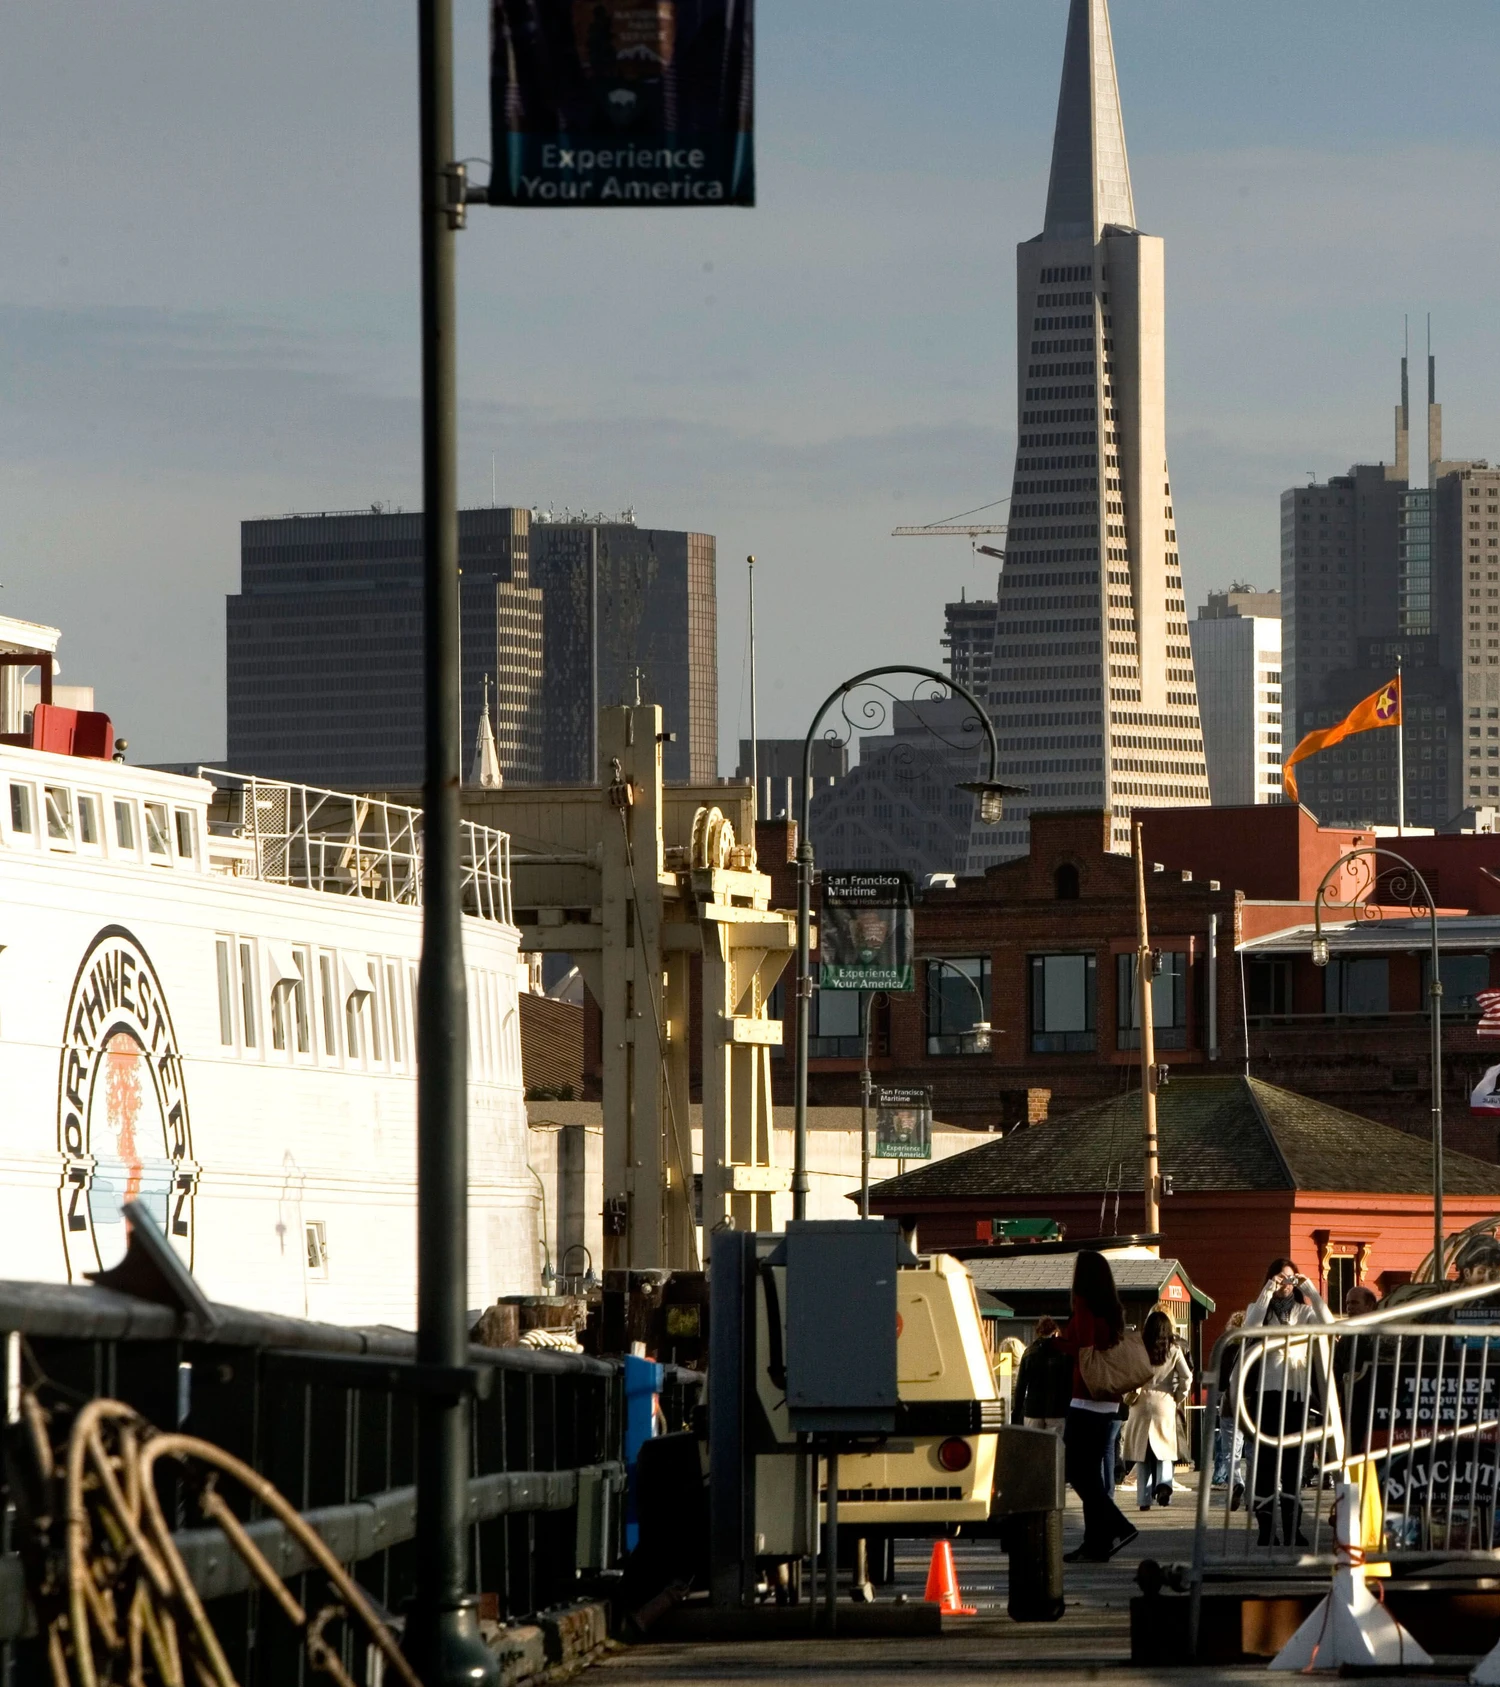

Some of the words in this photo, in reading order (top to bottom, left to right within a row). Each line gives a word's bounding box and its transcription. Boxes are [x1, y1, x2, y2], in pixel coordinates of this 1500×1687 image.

[541, 144, 705, 175] Experience
[521, 176, 592, 200] Your
[600, 176, 724, 200] America
[827, 876, 848, 885] San
[850, 875, 900, 885] Francisco
[827, 886, 877, 896] Maritime
[839, 968, 897, 980] Experience
[832, 979, 857, 989] Your
[859, 979, 903, 989] America
[64, 949, 195, 1237] NORTHWESTERN
[1404, 1377, 1496, 1393] TICKET
[1377, 1407, 1402, 1420] TO
